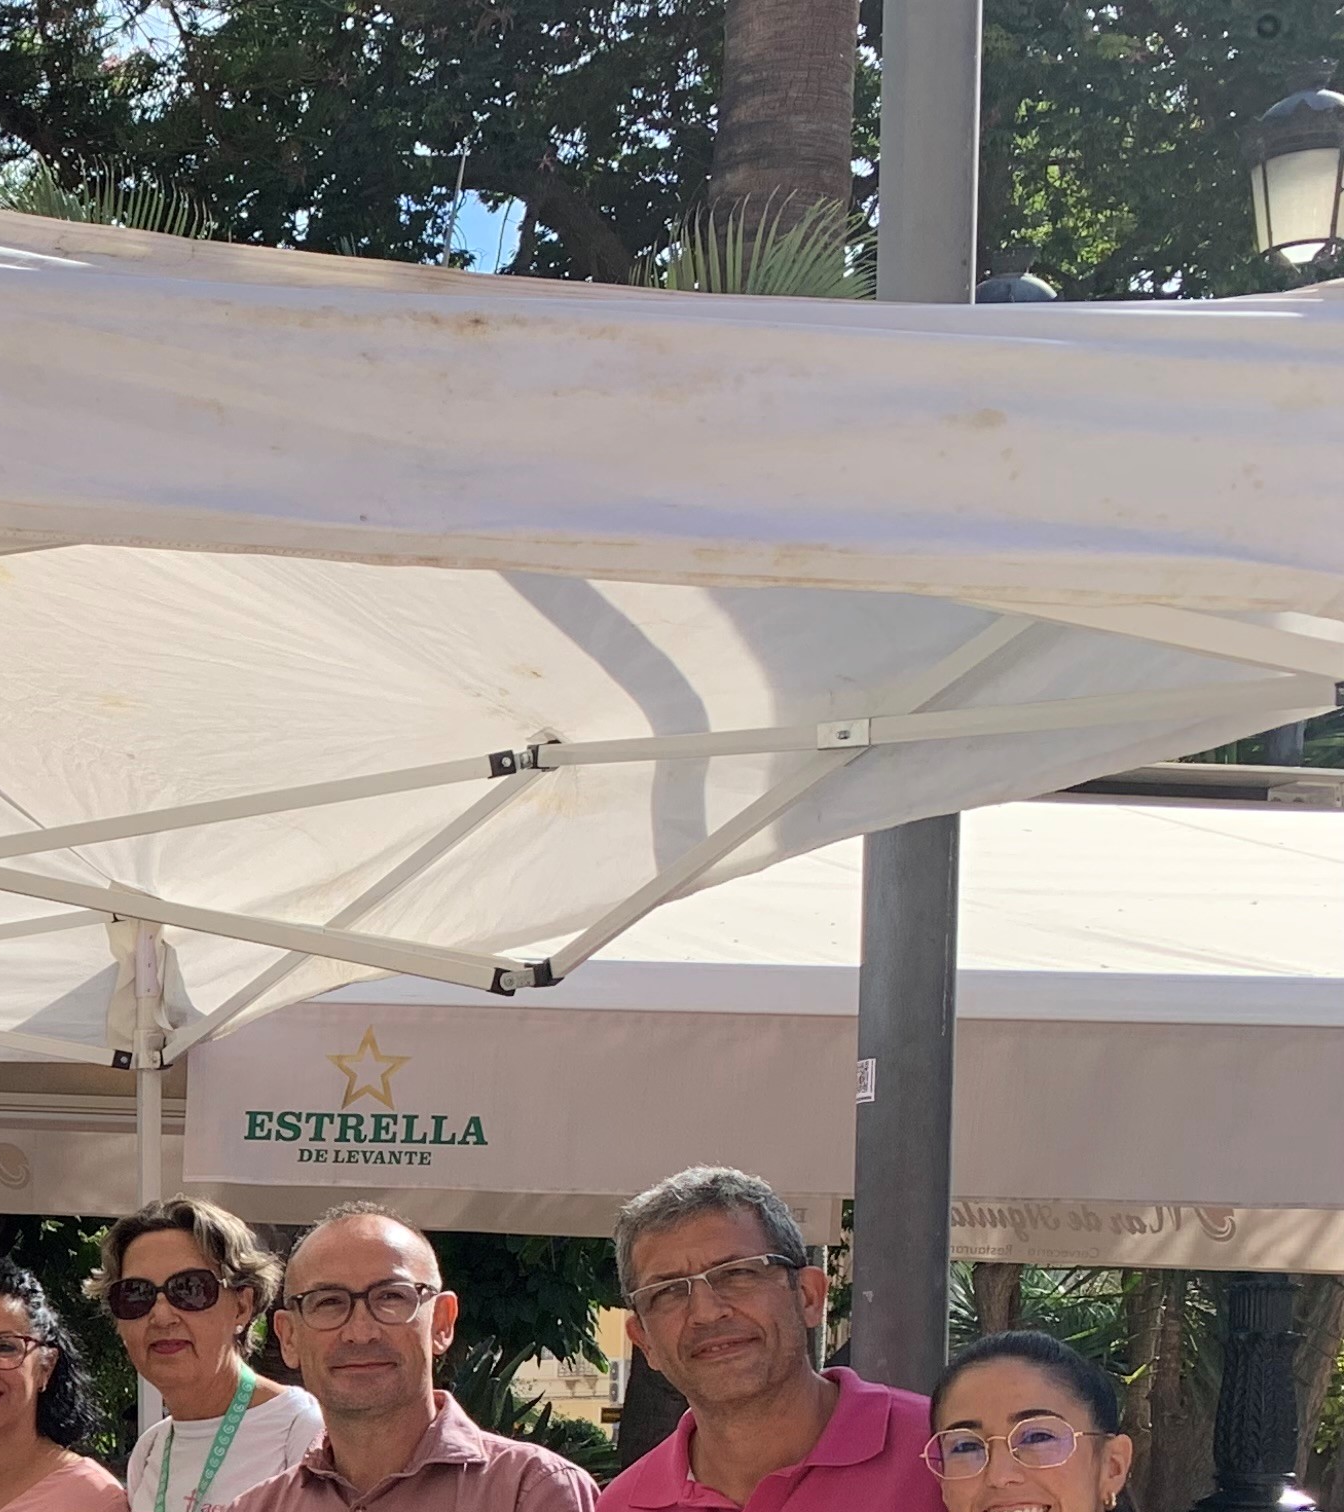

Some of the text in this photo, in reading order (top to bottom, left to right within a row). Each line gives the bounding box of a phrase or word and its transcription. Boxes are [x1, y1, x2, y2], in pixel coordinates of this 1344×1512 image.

[243, 1110, 489, 1146] ESTRELLA
[297, 1148, 432, 1166] DE LEVANTE
